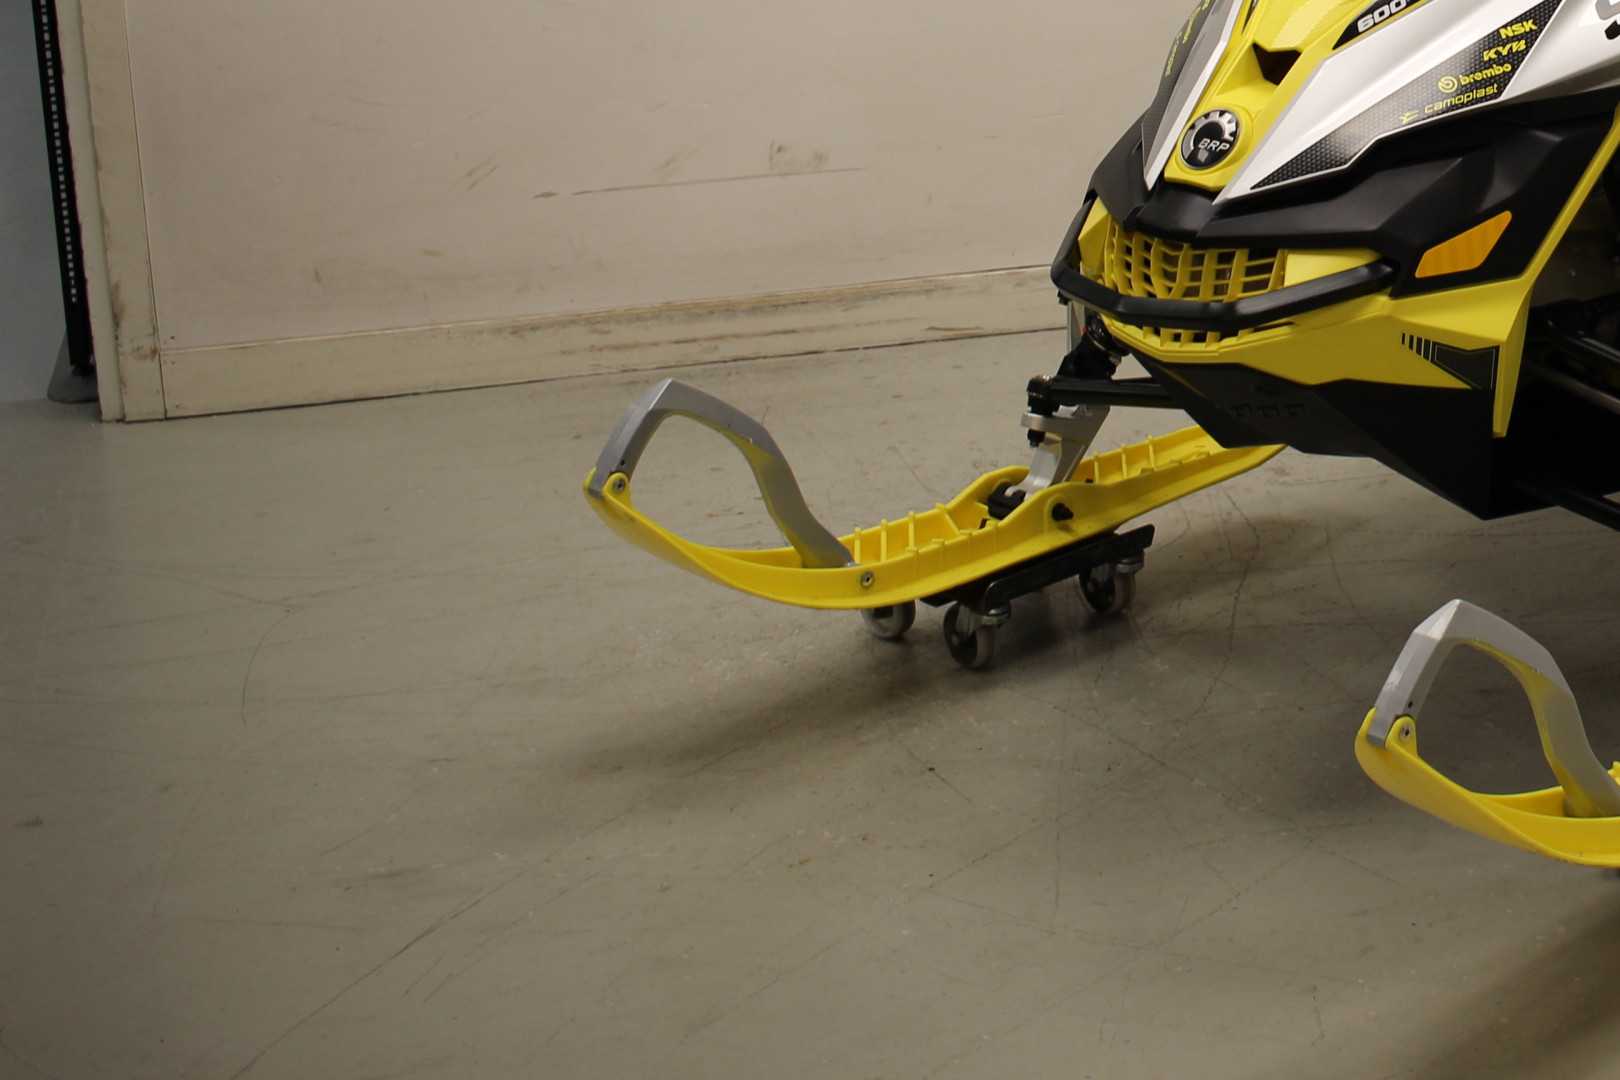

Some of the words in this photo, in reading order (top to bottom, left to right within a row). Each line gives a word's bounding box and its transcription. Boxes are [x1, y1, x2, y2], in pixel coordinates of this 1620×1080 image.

[1499, 19, 1539, 39] NSK
[1482, 39, 1527, 61] KYB
[1459, 63, 1512, 86] brembo
[1424, 83, 1498, 114] camoplast
[1198, 137, 1230, 153] BRP
